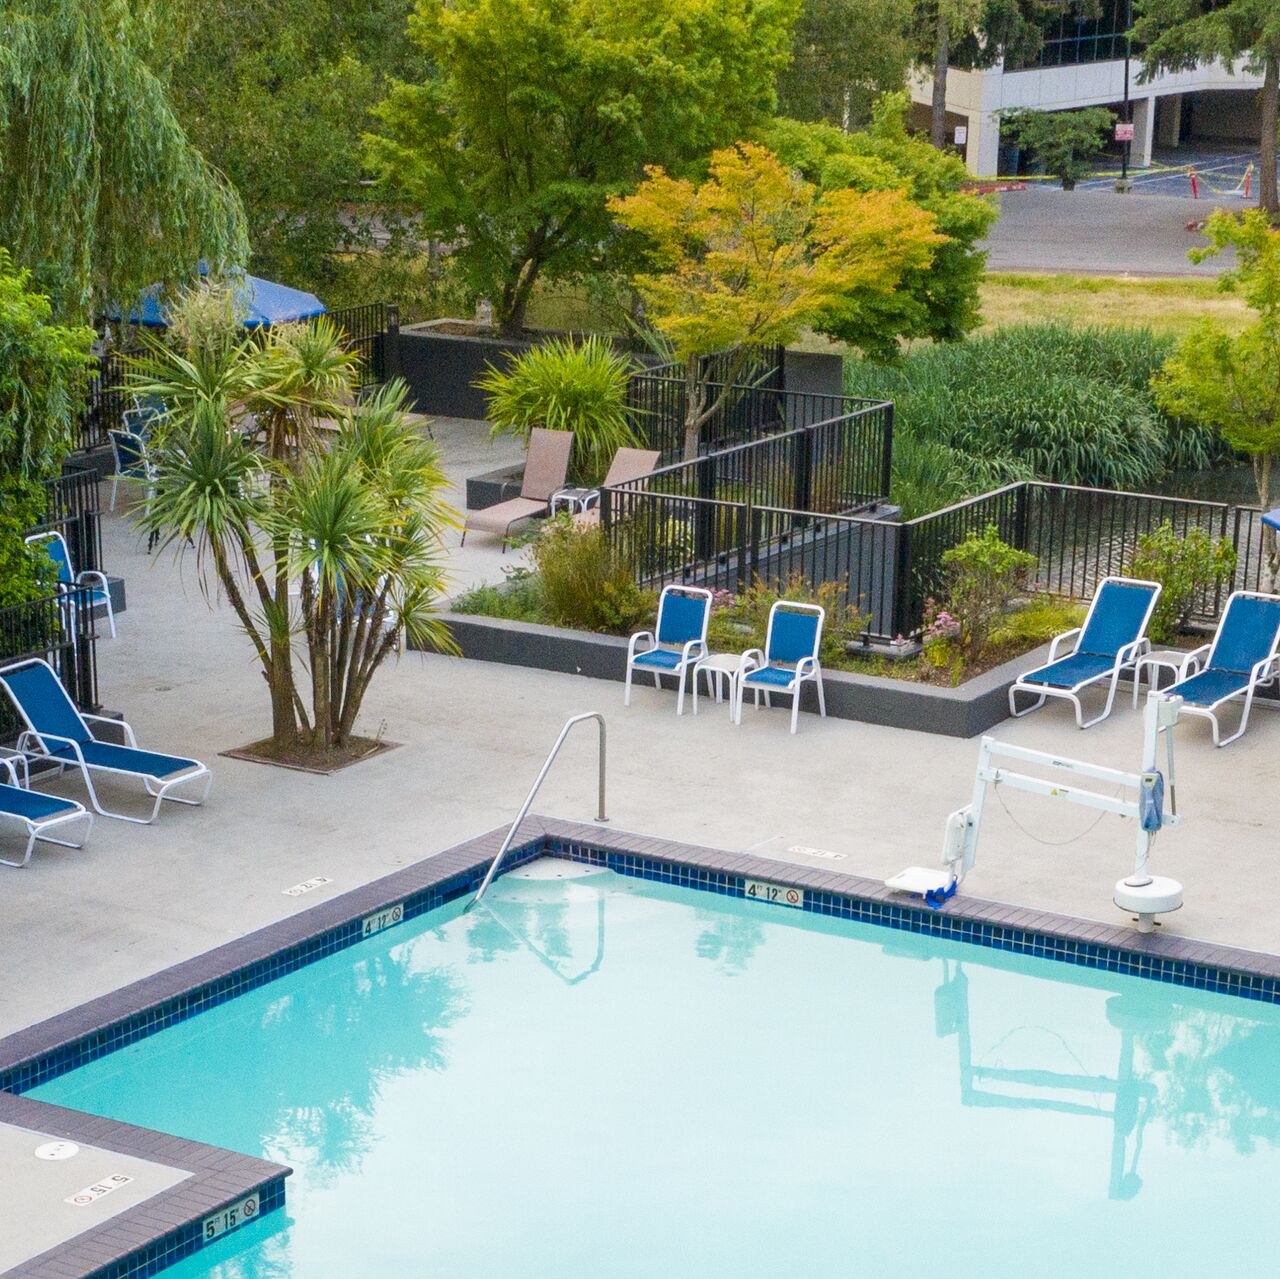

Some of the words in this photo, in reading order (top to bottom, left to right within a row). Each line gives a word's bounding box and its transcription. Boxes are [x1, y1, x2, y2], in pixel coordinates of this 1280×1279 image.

[748, 884, 757, 897] 4
[365, 920, 371, 933] 4
[206, 1220, 215, 1238] 5
